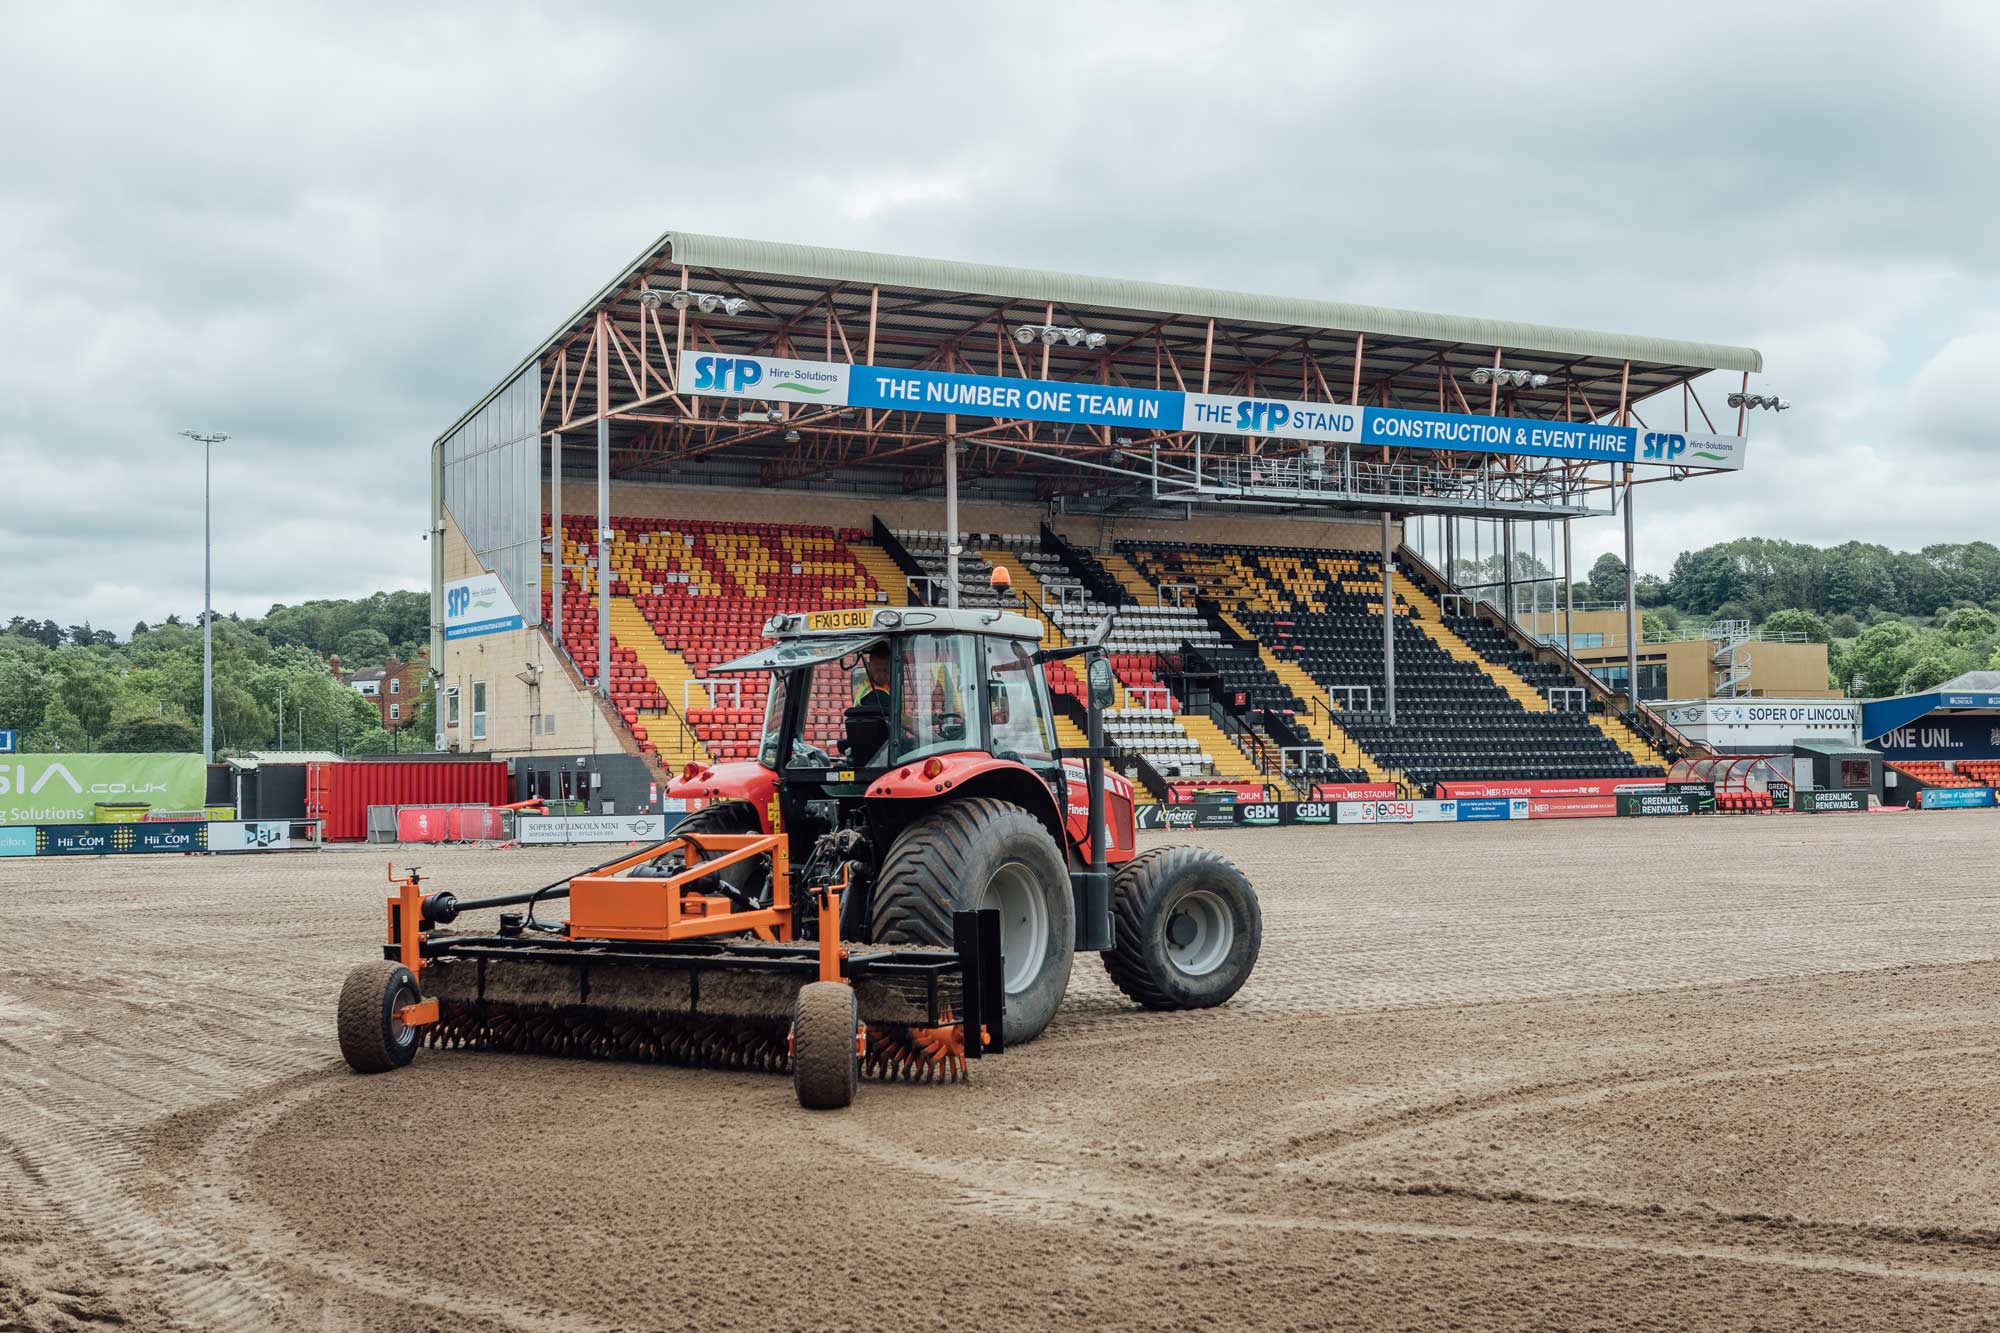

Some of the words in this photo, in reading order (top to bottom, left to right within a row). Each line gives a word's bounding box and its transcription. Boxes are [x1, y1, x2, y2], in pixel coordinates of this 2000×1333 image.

[695, 356, 762, 393] srp
[876, 378, 921, 400] THE
[927, 382, 1020, 408] NUMBER
[1026, 390, 1071, 412] ONE
[1077, 394, 1133, 417] TEAM
[1138, 399, 1159, 419] IN
[1194, 403, 1232, 423] THE
[1236, 400, 1290, 433] srp
[1292, 411, 1354, 432] STAND
[1372, 417, 1511, 444] CONSTRUCTION
[1515, 428, 1527, 445] &
[1531, 429, 1586, 450] EVENT
[1589, 433, 1627, 452] HIRE
[1643, 432, 1686, 461] srp
[447, 586, 470, 618] srp
[815, 614, 840, 628] FX13
[843, 612, 867, 626] CBU
[1748, 708, 1788, 721] SOPER
[1790, 708, 1805, 721] OF
[1808, 708, 1855, 721] LINCOLN
[1880, 728, 1917, 748] ONE
[1237, 792, 1260, 800] ADIUM
[1342, 791, 1363, 799] LNER
[1363, 790, 1395, 798] STADIUM
[1482, 788, 1501, 796] LNER
[1502, 788, 1531, 796] STADIUM
[1815, 792, 1853, 801] GREENLINC
[1642, 796, 1682, 805] GREENLINC
[1815, 801, 1859, 809] RENEWABLES
[10, 807, 84, 821] Solutions
[1155, 809, 1195, 822] Kinetic
[1244, 804, 1279, 818] GBM
[1296, 803, 1330, 817] GBM
[1378, 802, 1414, 819] easy
[1642, 805, 1688, 813] RENEWABLES
[528, 823, 552, 831] SOPER
[554, 823, 566, 831] OF
[567, 823, 599, 831] LINCOLN
[601, 822, 619, 830] MINI
